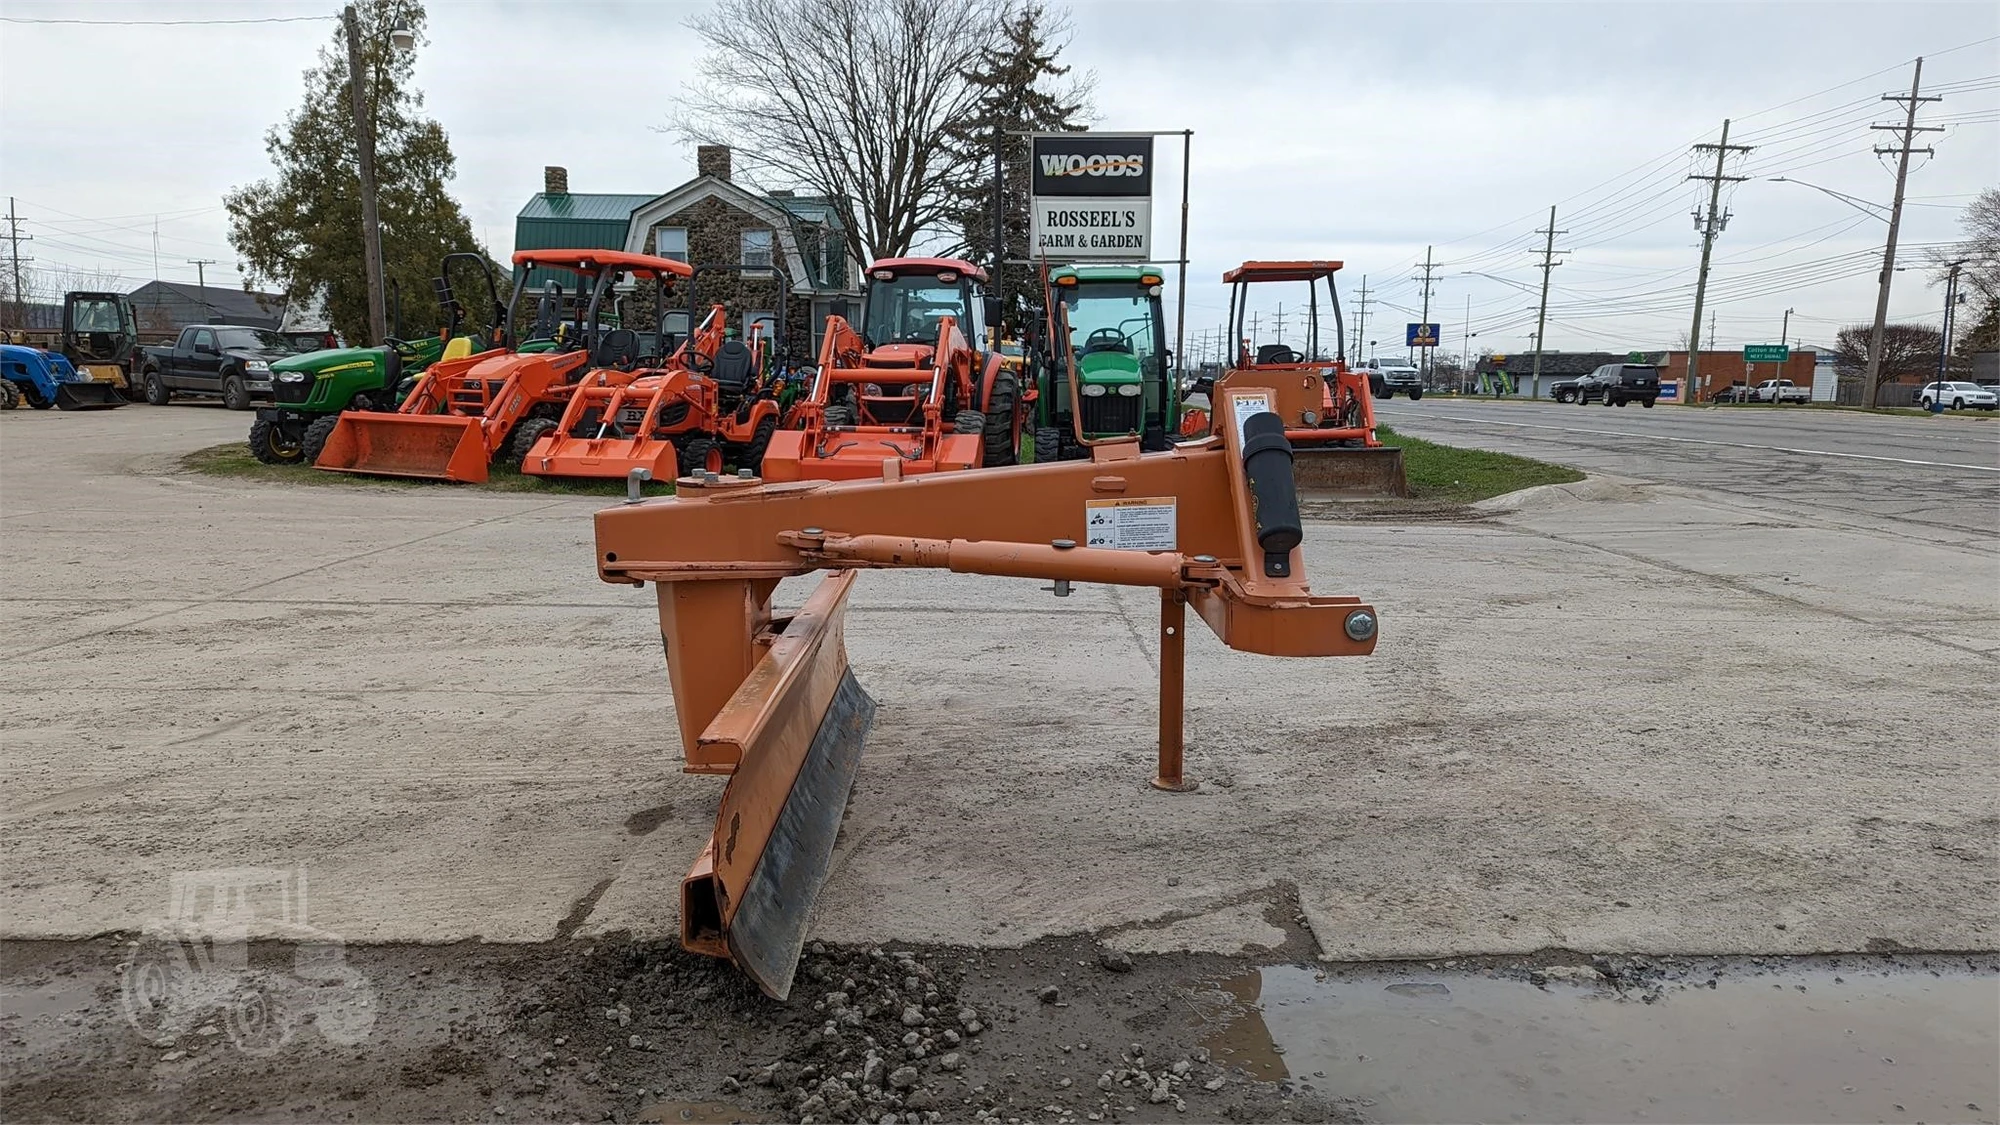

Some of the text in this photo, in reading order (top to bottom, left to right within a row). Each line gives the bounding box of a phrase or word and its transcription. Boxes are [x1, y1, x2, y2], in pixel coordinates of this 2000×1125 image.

[1040, 154, 1144, 177] WOODS
[1047, 210, 1135, 228] ROSSEEL'S
[1078, 234, 1088, 248] &
[1090, 234, 1143, 248] GARDEN
